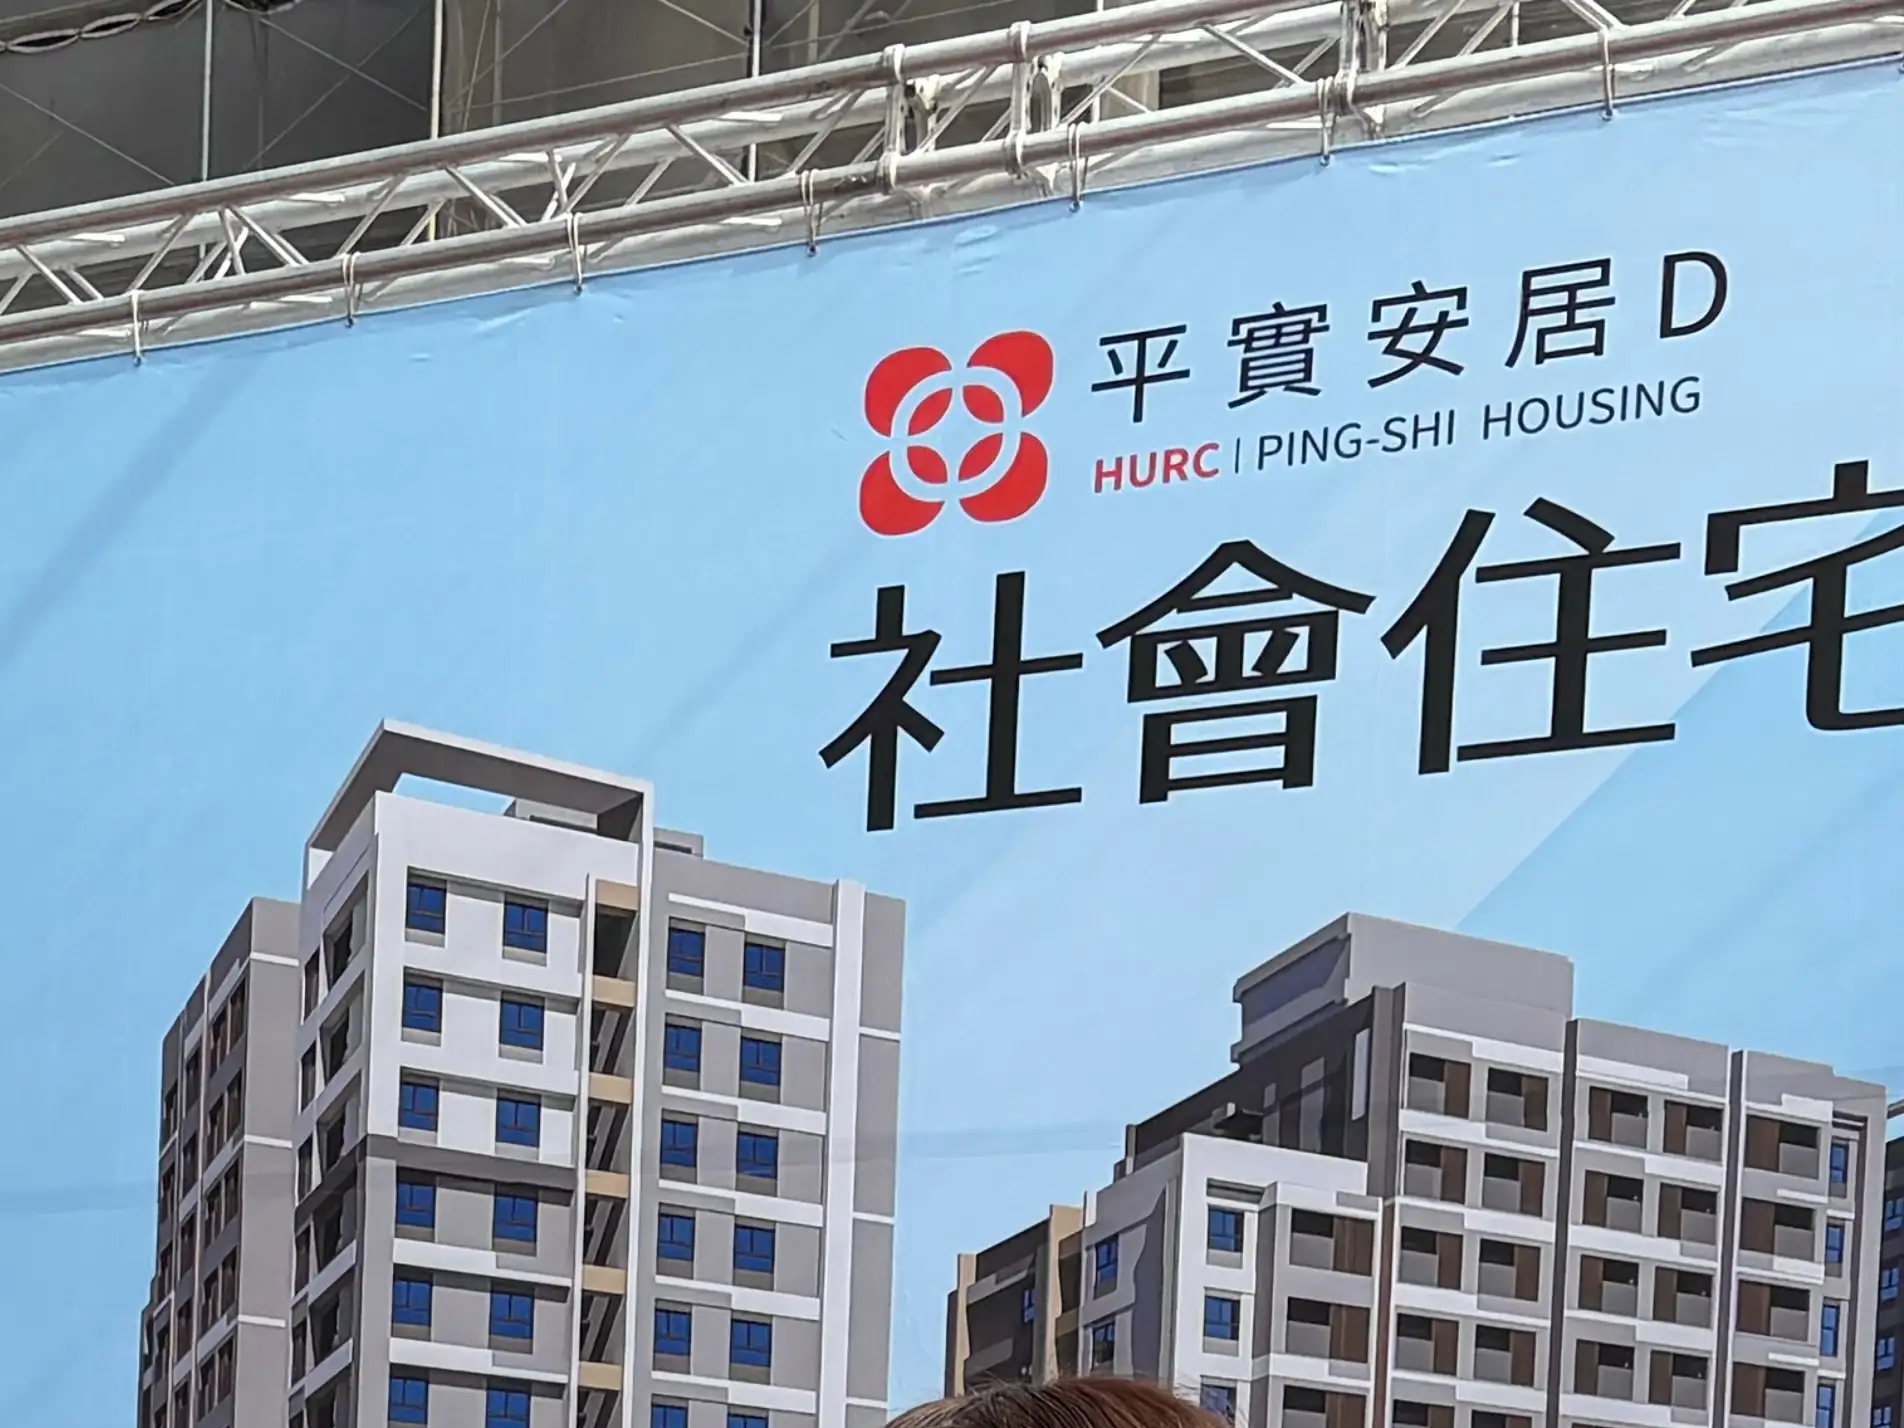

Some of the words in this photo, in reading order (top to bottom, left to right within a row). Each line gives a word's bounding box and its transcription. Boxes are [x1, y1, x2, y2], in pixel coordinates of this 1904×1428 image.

[1091, 250, 1730, 426] 平實安居D
[1093, 441, 1221, 494] HURC
[1256, 408, 1456, 473] PING-SHI
[1481, 376, 1703, 440] HOUSING
[818, 460, 1904, 833] 社會住宅
